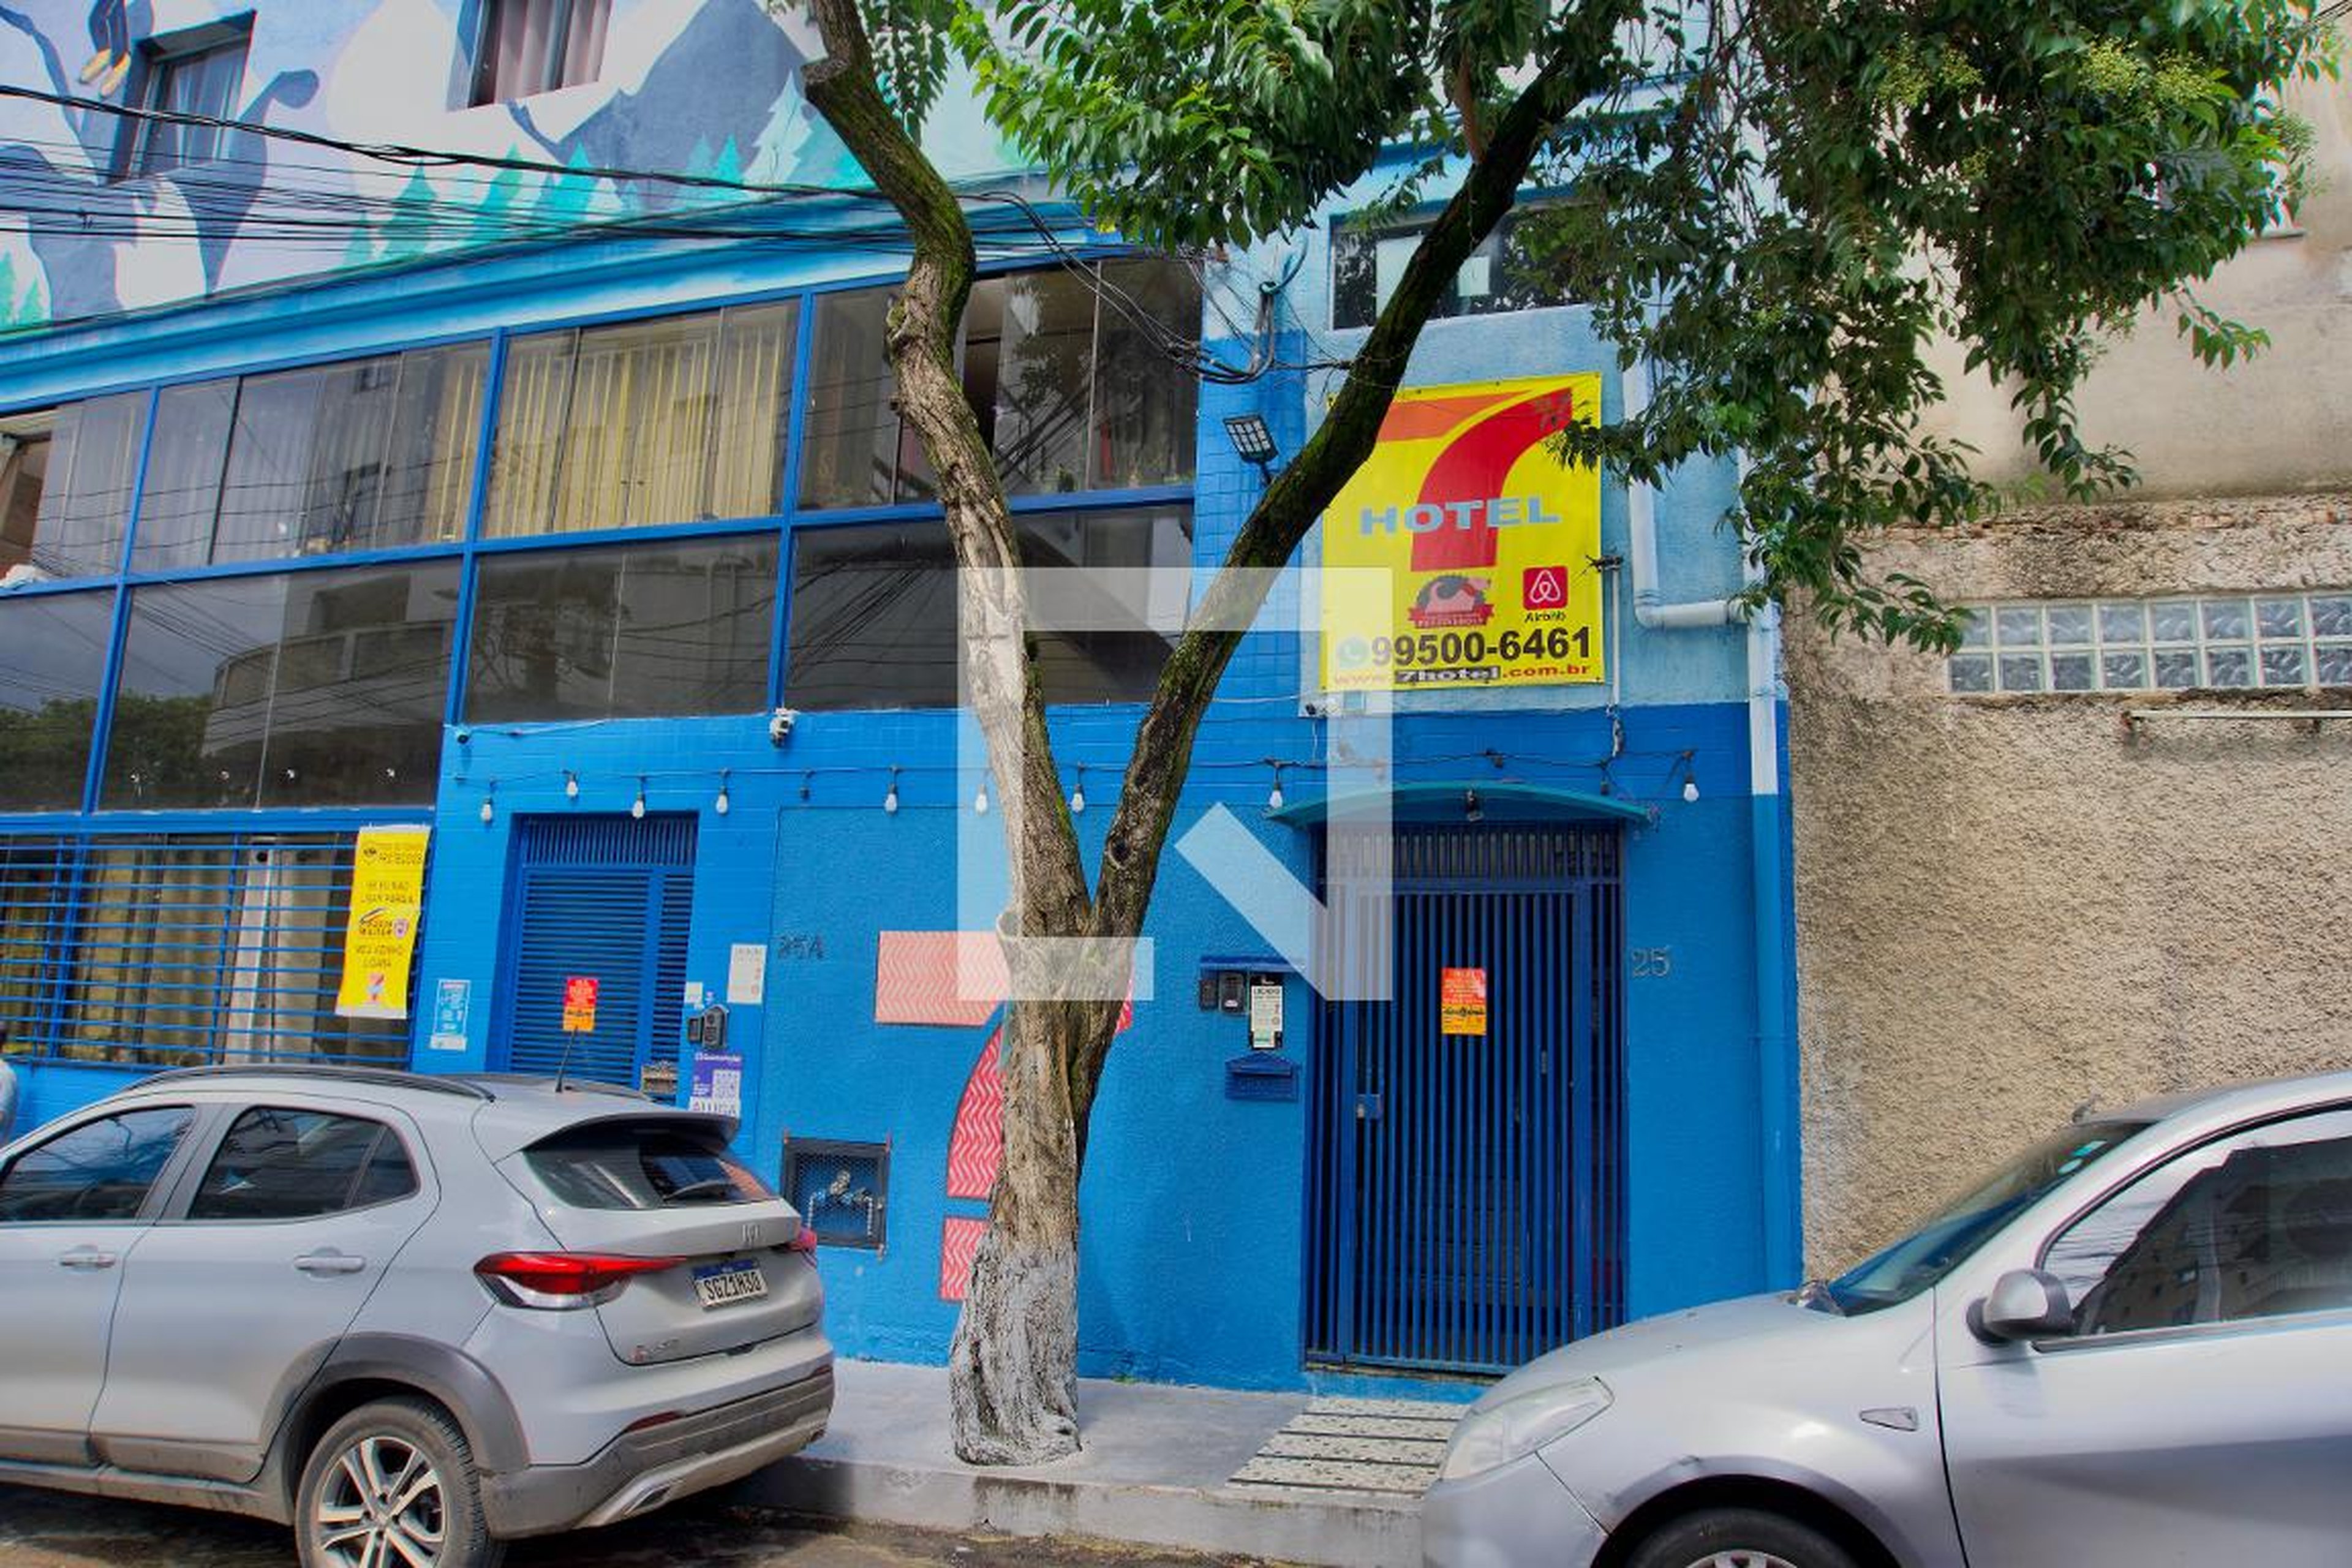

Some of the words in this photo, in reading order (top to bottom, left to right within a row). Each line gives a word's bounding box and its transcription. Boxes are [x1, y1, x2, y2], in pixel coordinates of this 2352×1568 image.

[1359, 497, 1561, 535] HOTEL
[1372, 627, 1590, 666] 99500-6461
[1632, 948, 1670, 977] 25
